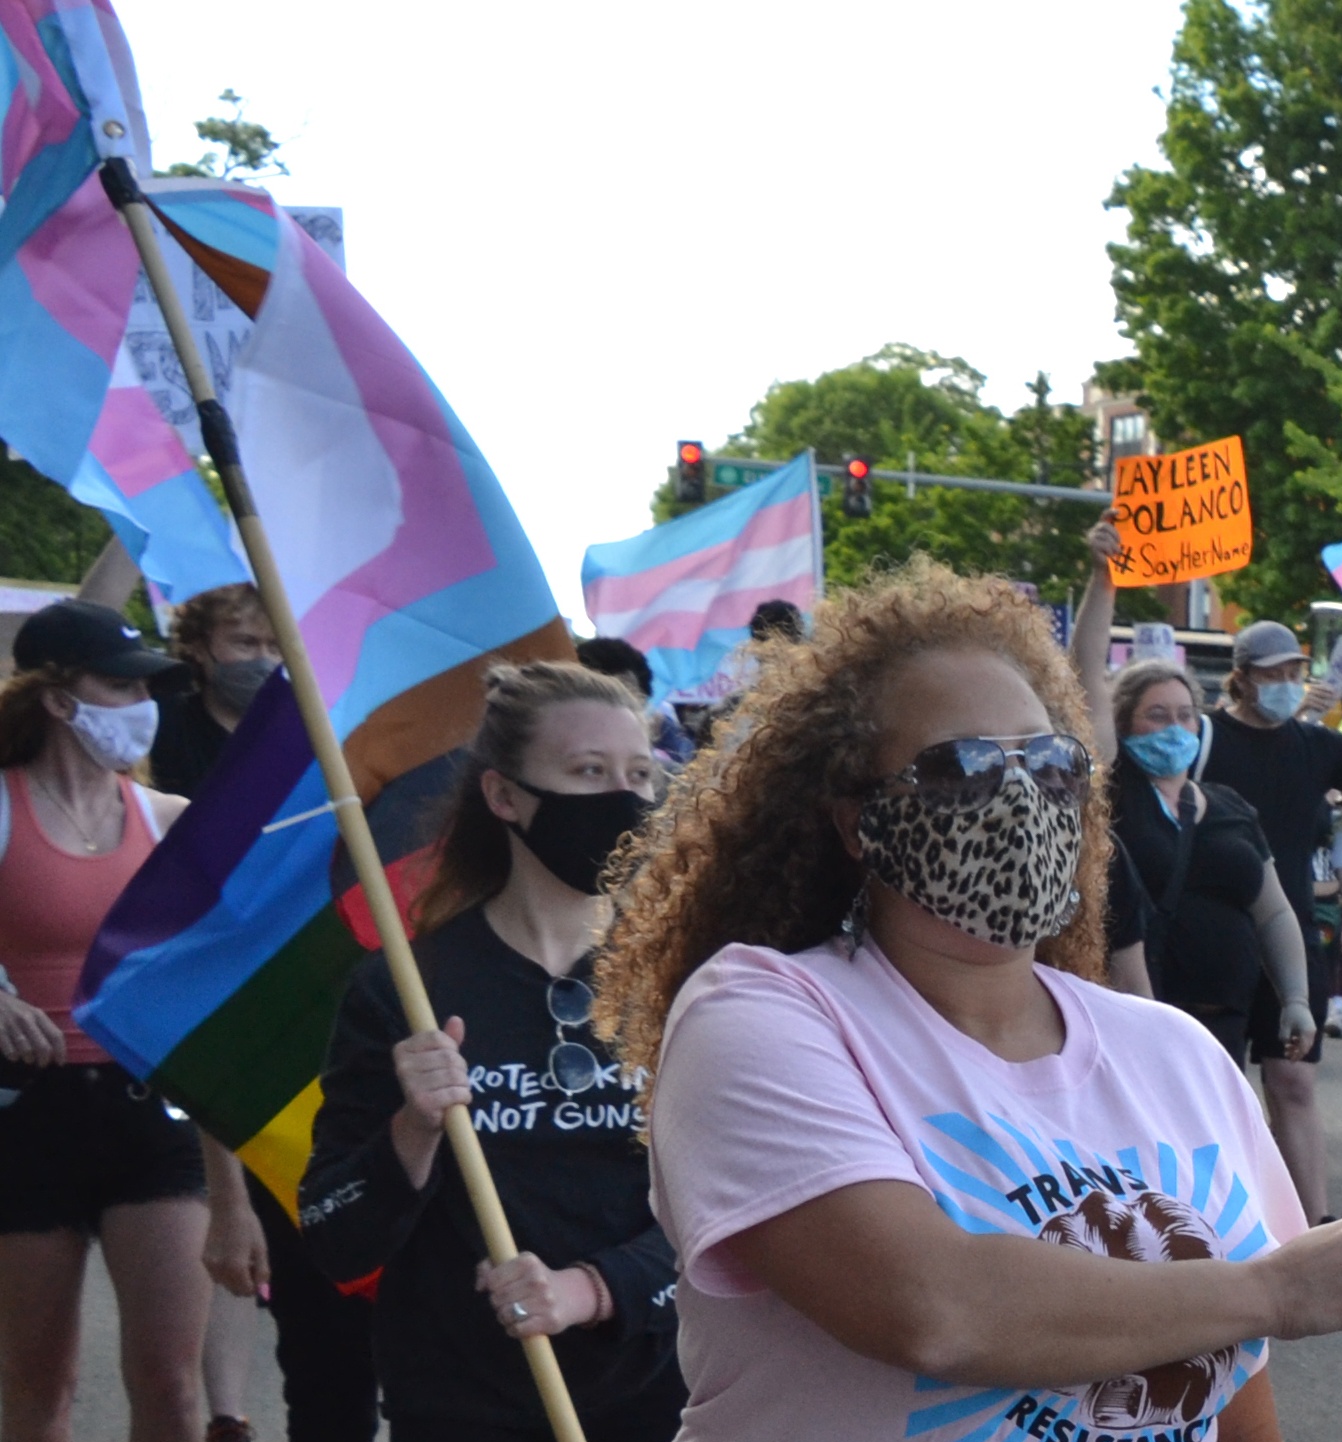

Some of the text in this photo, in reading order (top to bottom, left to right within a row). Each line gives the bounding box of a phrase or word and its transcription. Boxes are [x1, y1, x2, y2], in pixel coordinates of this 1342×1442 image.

[1117, 445, 1231, 496] LAYLEEN
[1112, 480, 1243, 535] POLANCO
[473, 1101, 547, 1133] NOT
[1005, 1160, 1148, 1226] TRANS
